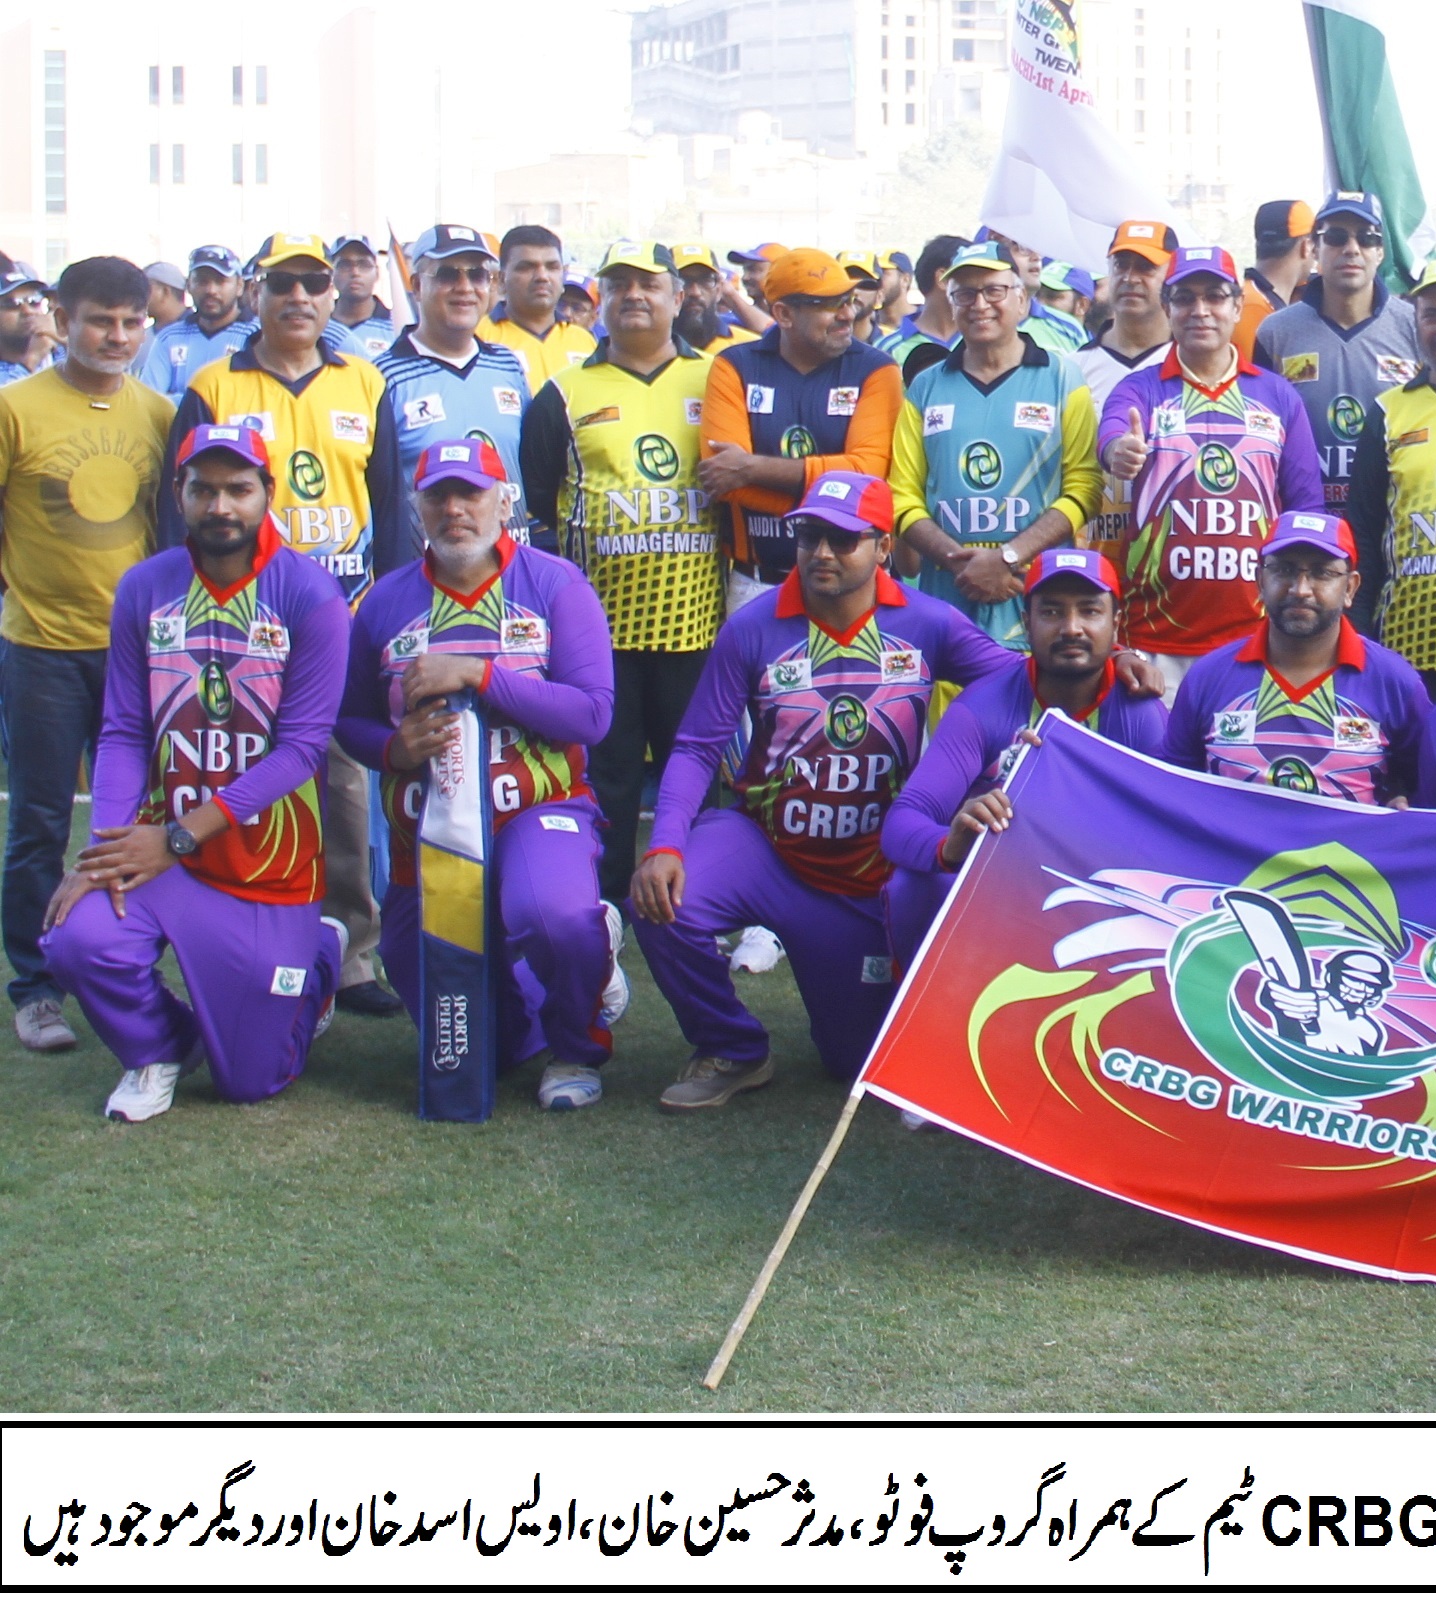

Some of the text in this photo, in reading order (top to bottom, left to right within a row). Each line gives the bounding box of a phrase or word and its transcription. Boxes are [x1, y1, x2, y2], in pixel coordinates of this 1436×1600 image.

[607, 488, 709, 528] NBP
[748, 515, 781, 538] AUDIT
[939, 497, 1031, 534] NBP
[1168, 499, 1262, 537] NBP
[597, 533, 717, 557] MANAGEMENT
[1169, 546, 1258, 582] CRBG
[167, 728, 266, 773] NBP
[789, 753, 893, 793] NBP
[783, 799, 880, 839] CRBG
[438, 993, 452, 1055] SPIRITS
[453, 993, 468, 1055] SPORTS
[1102, 1048, 1219, 1107] CRBG
